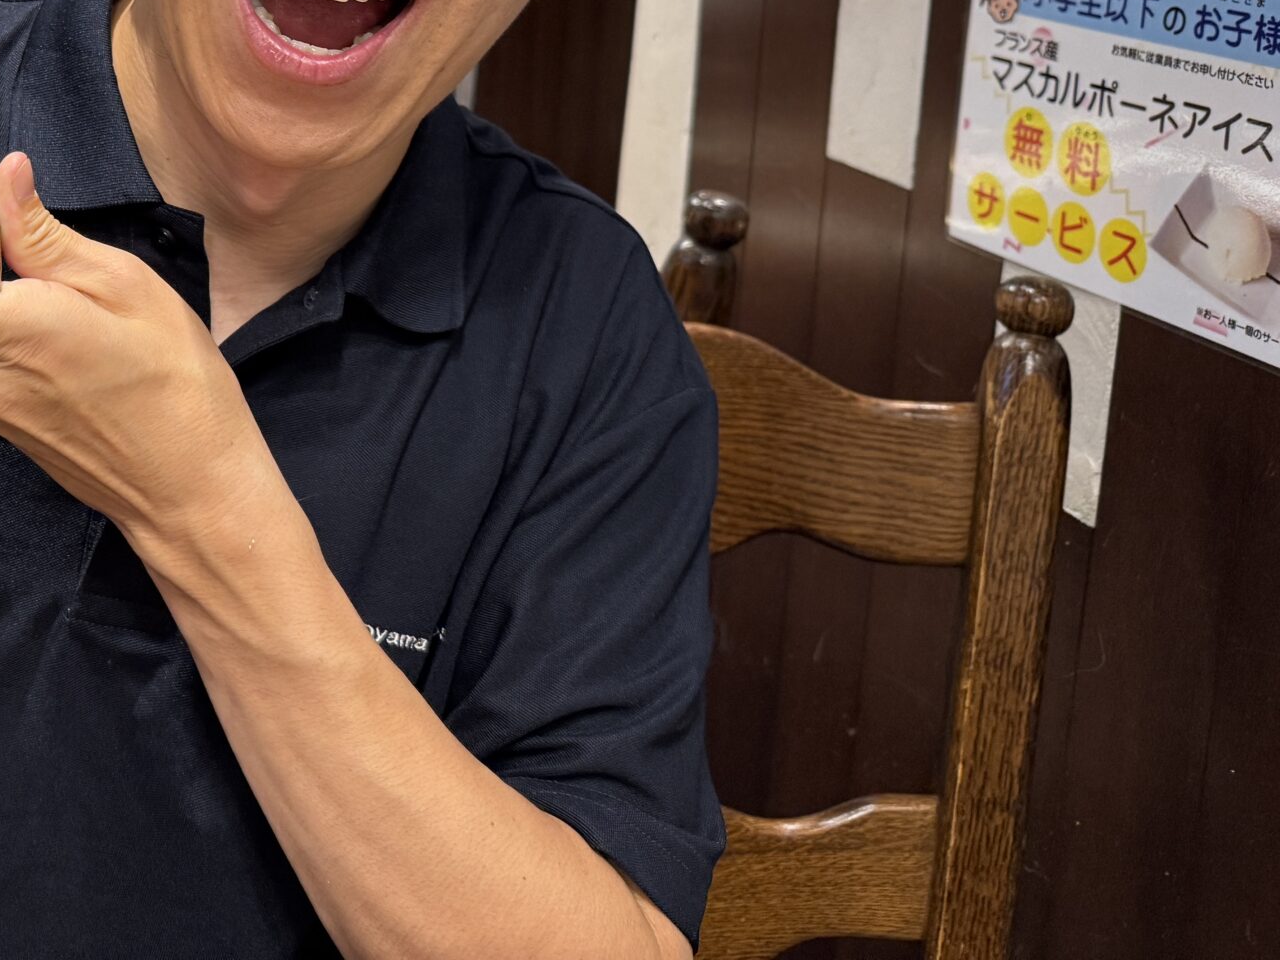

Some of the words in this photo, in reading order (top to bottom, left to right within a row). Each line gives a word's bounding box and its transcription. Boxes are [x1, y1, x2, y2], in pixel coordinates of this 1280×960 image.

[994, 29, 1059, 62] フランス産
[1111, 44, 1274, 89] お気軽に従業員までお申し付けください
[991, 55, 1274, 162] マスカルポーネアイス
[973, 182, 1137, 277] サービス
